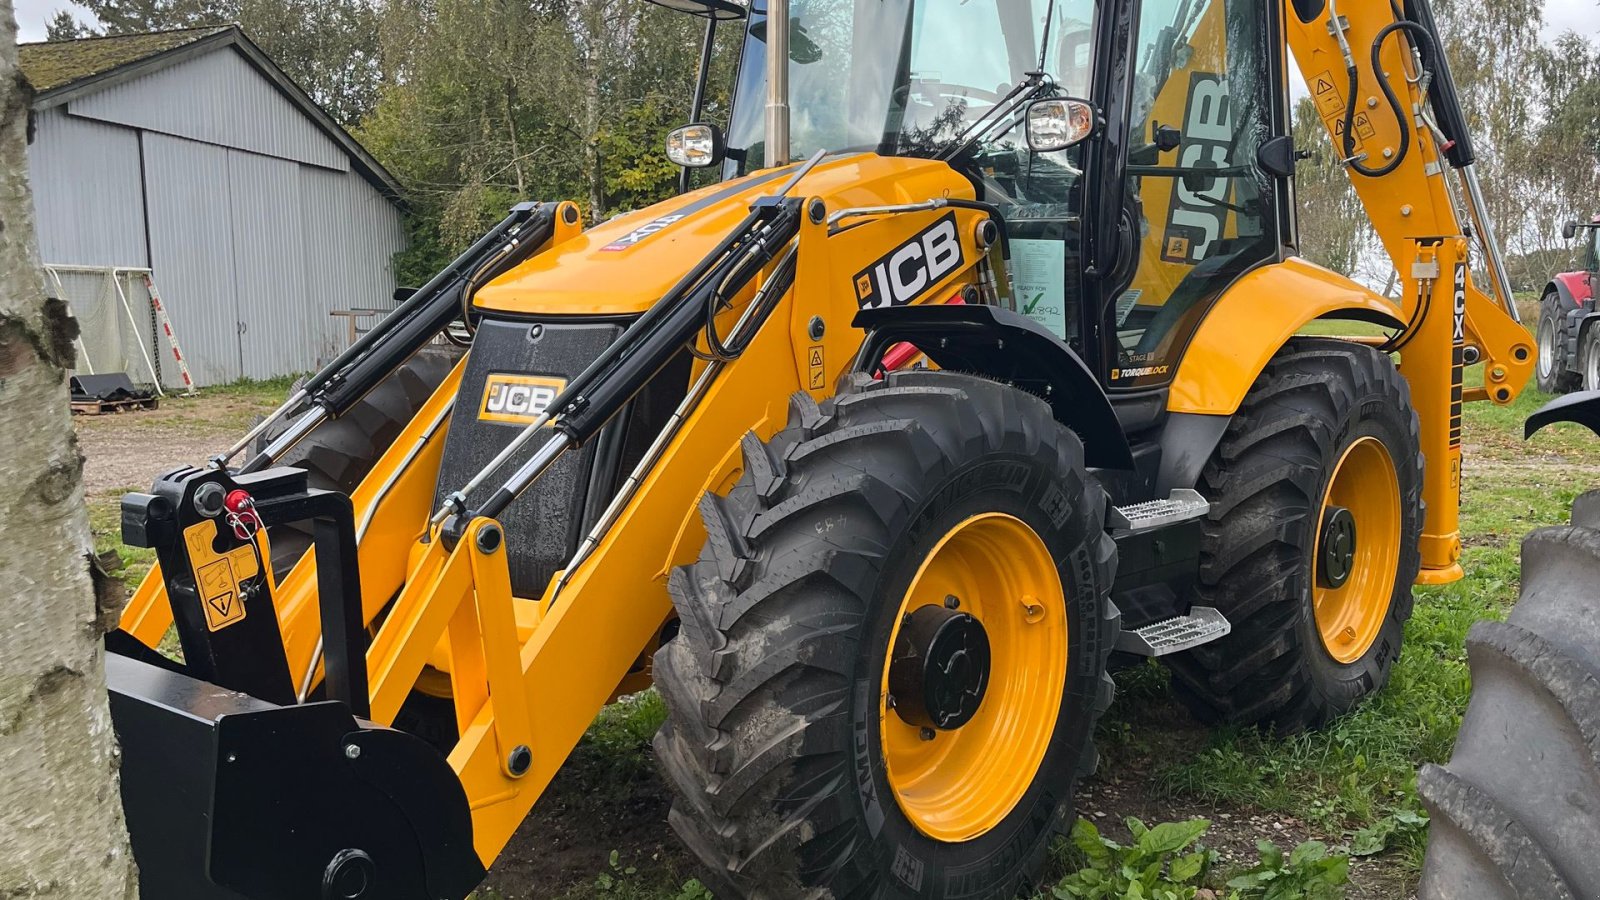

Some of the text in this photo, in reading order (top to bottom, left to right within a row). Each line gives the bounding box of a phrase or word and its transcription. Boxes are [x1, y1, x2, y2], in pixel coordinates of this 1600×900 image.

[1172, 79, 1232, 261] JCB
[863, 220, 960, 309] JCB
[1454, 265, 1465, 339] 4CX
[1121, 365, 1169, 378] TORQUELOCK
[1129, 353, 1146, 363] STAGE
[488, 384, 555, 414] JCB
[855, 711, 876, 812] XMCL
